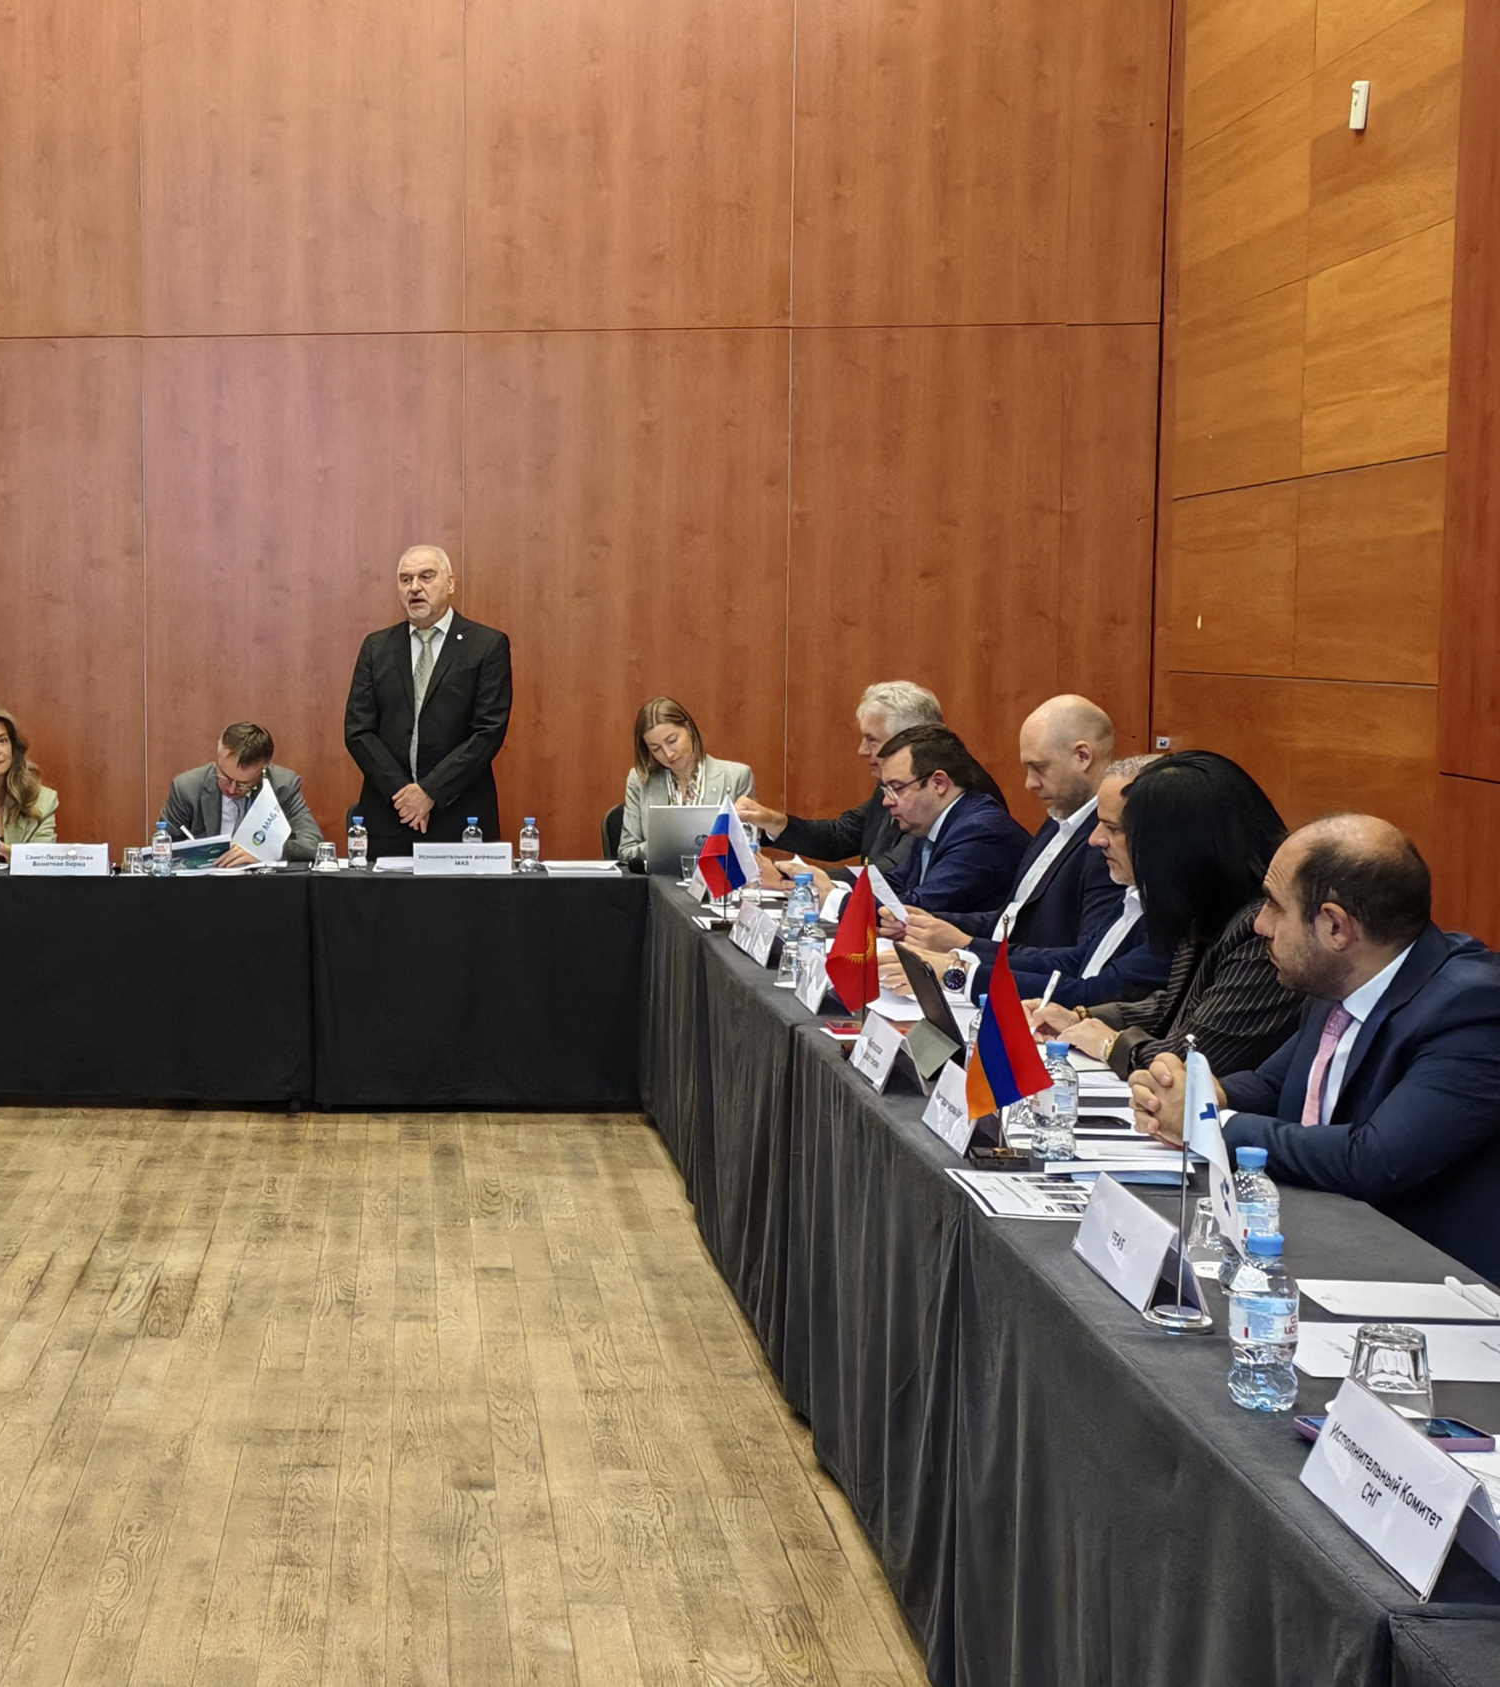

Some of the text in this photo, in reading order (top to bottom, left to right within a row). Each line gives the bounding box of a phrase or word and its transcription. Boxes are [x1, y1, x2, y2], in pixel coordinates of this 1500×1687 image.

[262, 812, 278, 831] МАБ
[1329, 1421, 1443, 1530] Исполнительный Комитет
[1361, 1482, 1382, 1508] СНГ
